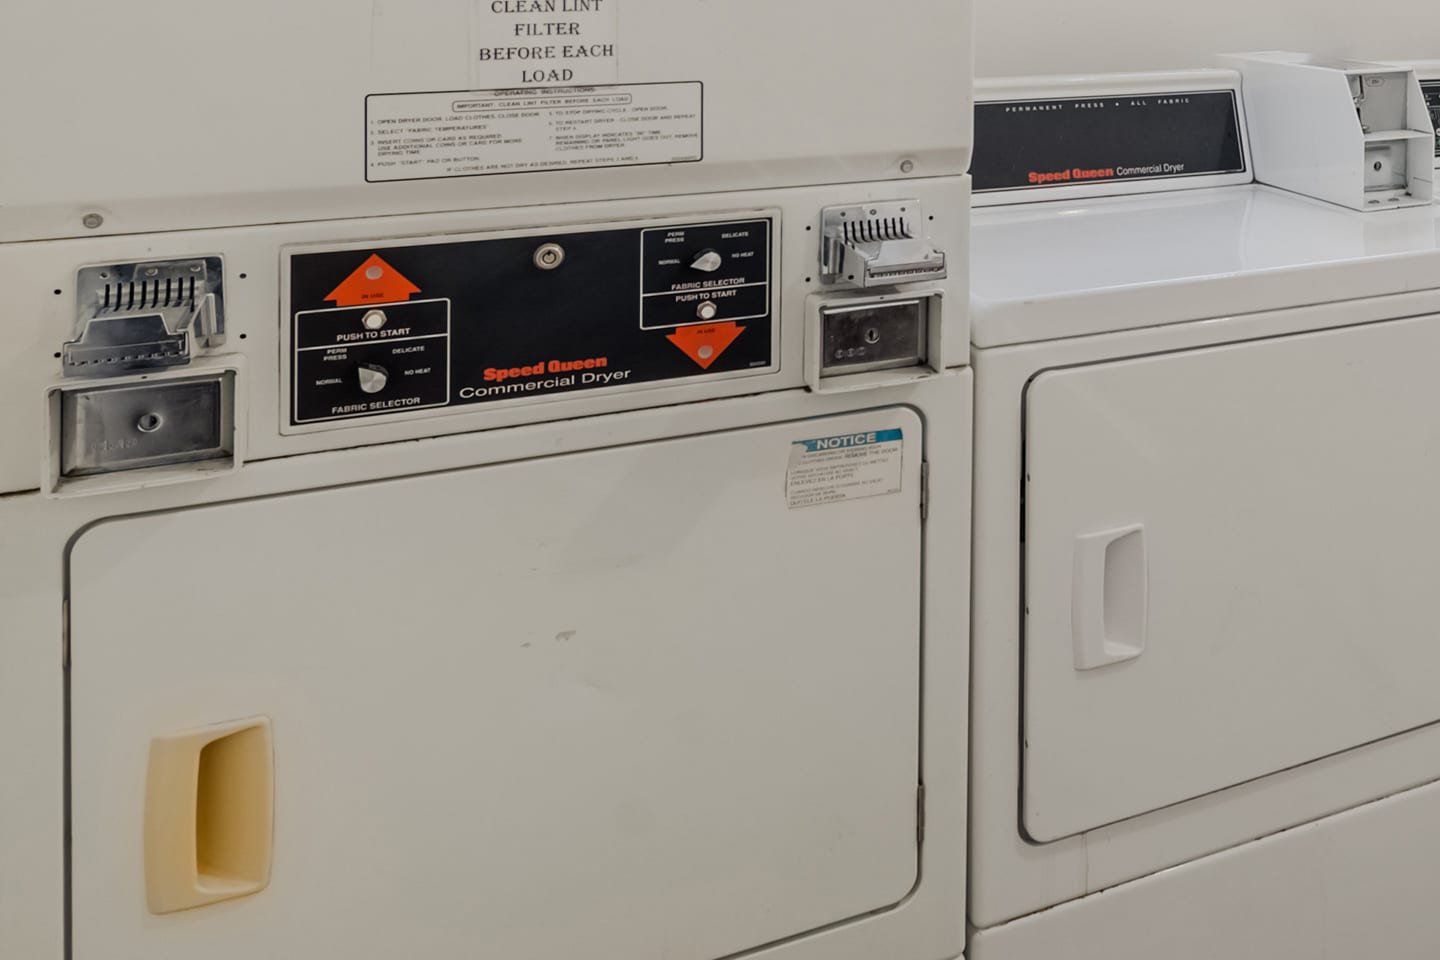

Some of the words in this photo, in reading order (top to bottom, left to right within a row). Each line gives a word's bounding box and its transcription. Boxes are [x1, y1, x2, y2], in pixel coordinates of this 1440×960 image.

[491, 0, 556, 13] CLEAN
[562, 0, 603, 12] LINT
[515, 22, 580, 36] FILTER
[480, 46, 556, 60] BEFORE
[563, 44, 614, 58] EACH
[522, 69, 573, 83] LOAD
[1005, 104, 1063, 112] PERMANENT
[1028, 170, 1070, 184] Speed
[1072, 167, 1114, 179] Queen
[1116, 163, 1162, 176] Commercial
[1163, 163, 1185, 173] Dryer
[672, 281, 701, 290] FABRIC
[702, 277, 745, 288] SELECTOR
[712, 290, 736, 298] START
[337, 333, 364, 342] PUSH
[366, 331, 378, 339] TO
[380, 328, 411, 337] START
[392, 346, 425, 354] DELICATE
[483, 362, 545, 382] Speed
[548, 357, 608, 372] Queen
[459, 375, 575, 398] Commercial
[582, 370, 631, 384] Dryer
[332, 403, 367, 414] FABRIC
[369, 397, 420, 410] SELECTOR
[816, 432, 876, 450] NOTICE
